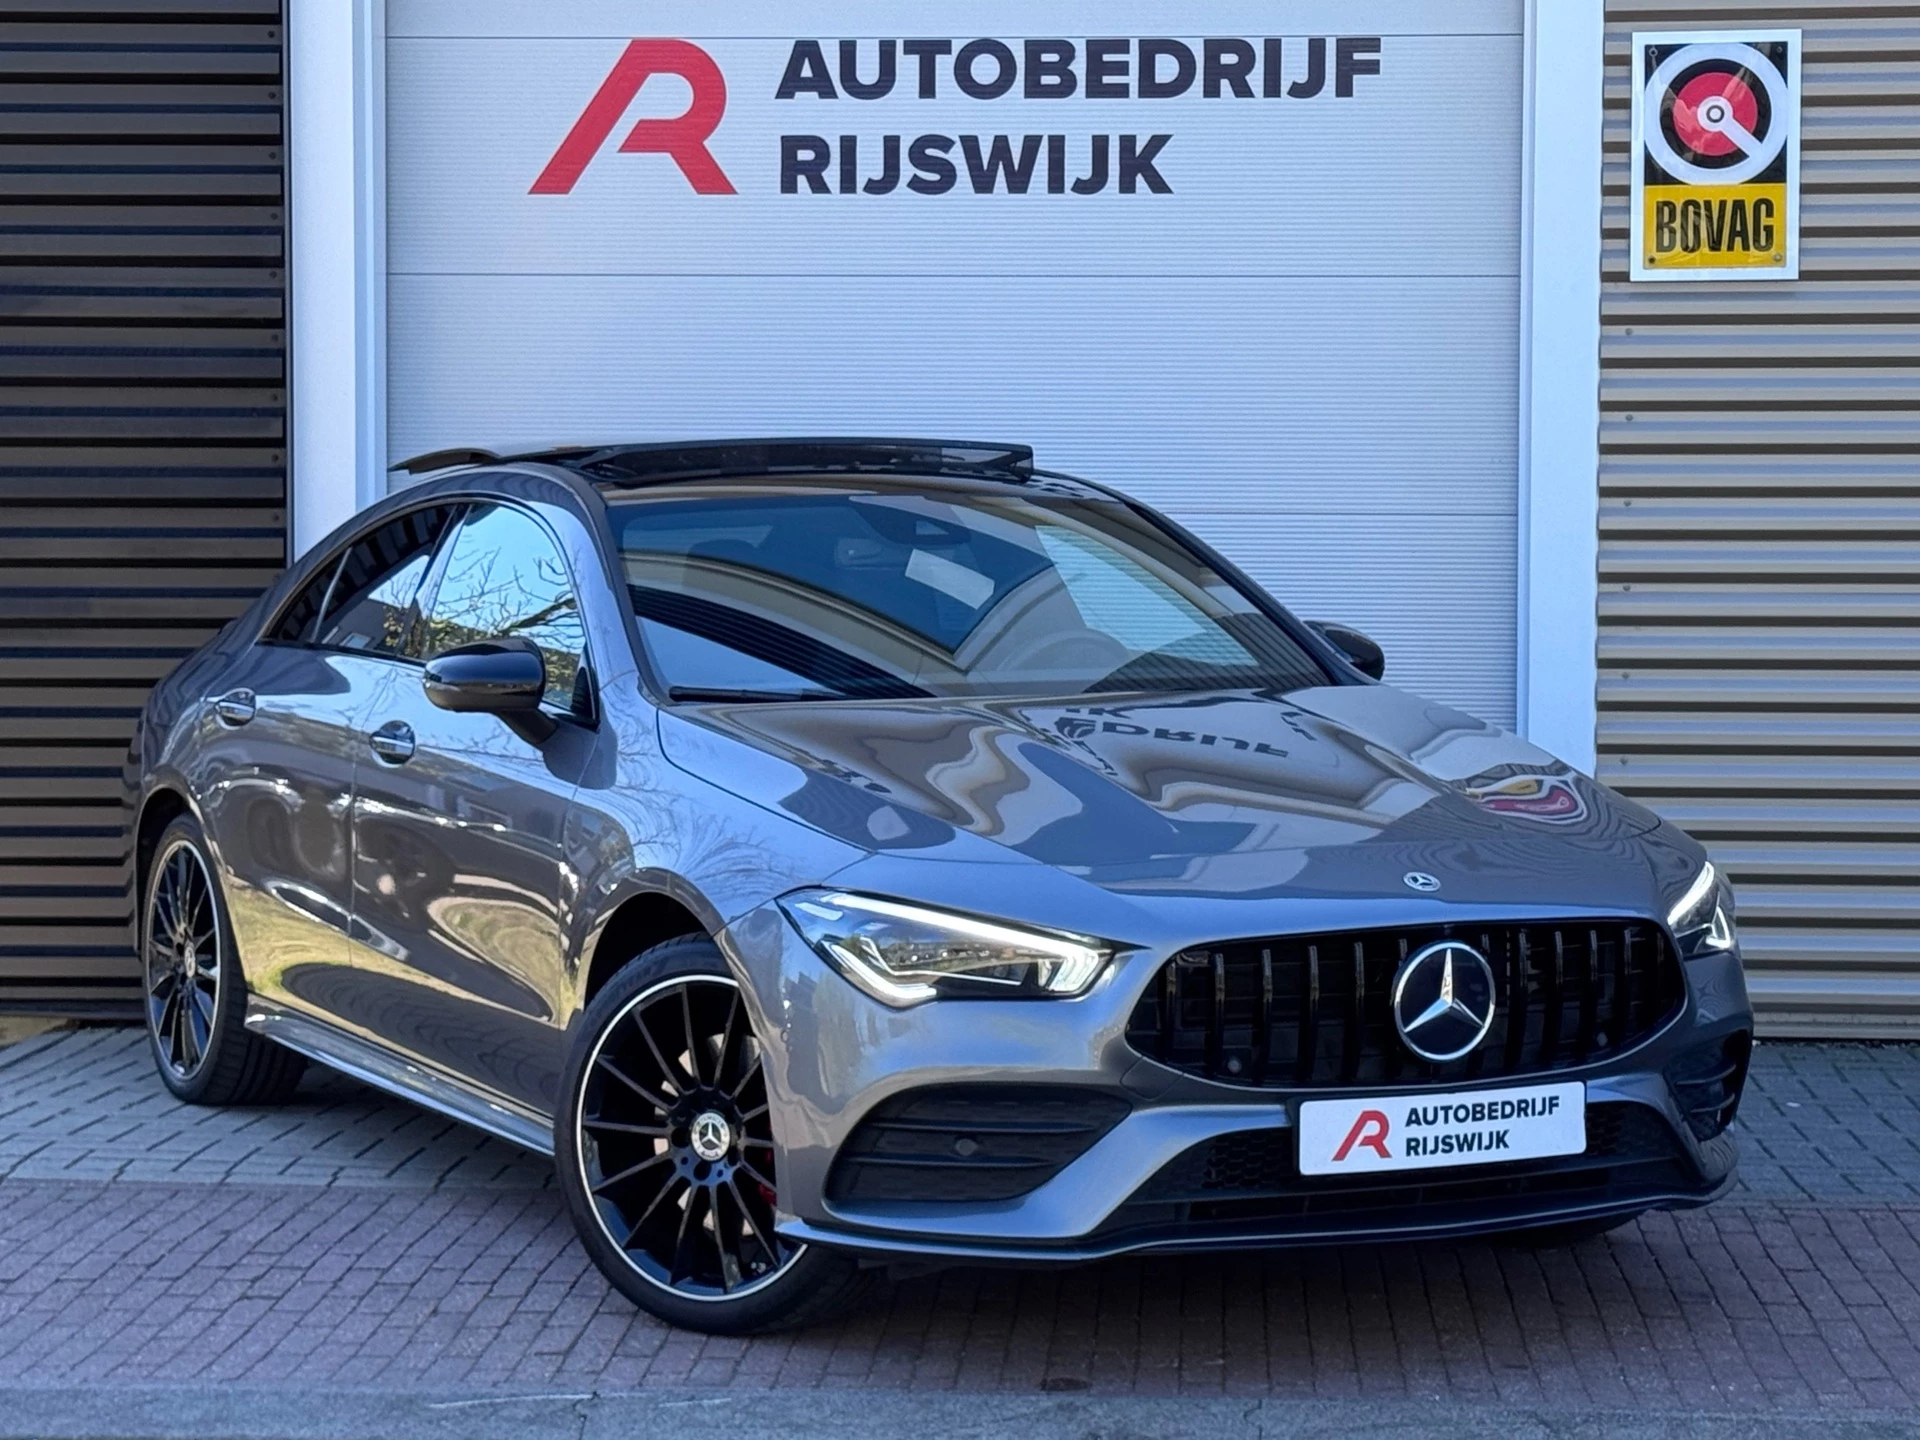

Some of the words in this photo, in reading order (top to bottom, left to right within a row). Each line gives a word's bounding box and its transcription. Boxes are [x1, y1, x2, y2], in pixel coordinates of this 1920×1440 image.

[776, 37, 1381, 100] AUTOBEDRIJF
[780, 134, 1173, 195] RIJSWIJK
[1655, 197, 1774, 254] BOVAG
[1405, 1095, 1560, 1127] AUTOBEDRIJF
[1405, 1129, 1510, 1157] RIJSWIJK
